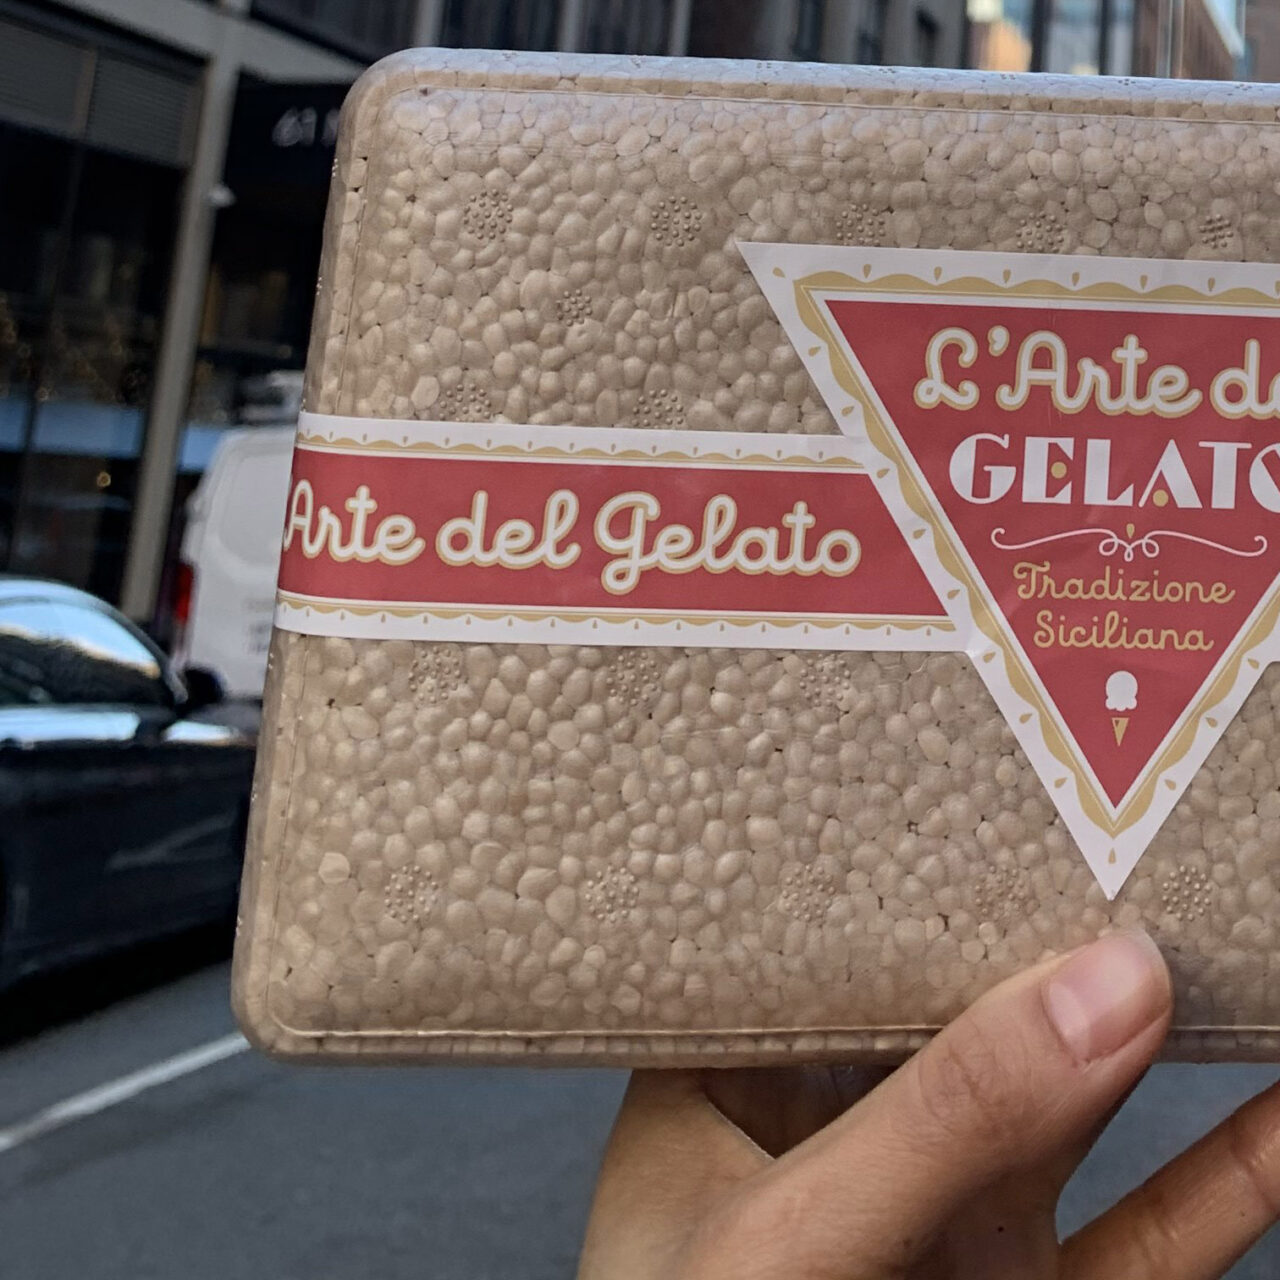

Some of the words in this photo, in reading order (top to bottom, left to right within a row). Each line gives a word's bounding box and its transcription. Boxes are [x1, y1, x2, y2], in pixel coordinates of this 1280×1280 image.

[914, 325, 1202, 417] L'Arte
[435, 489, 581, 570] del
[593, 490, 861, 595] Gelato
[1013, 560, 1236, 604] Tradizione
[1033, 609, 1214, 651] Siciliana
